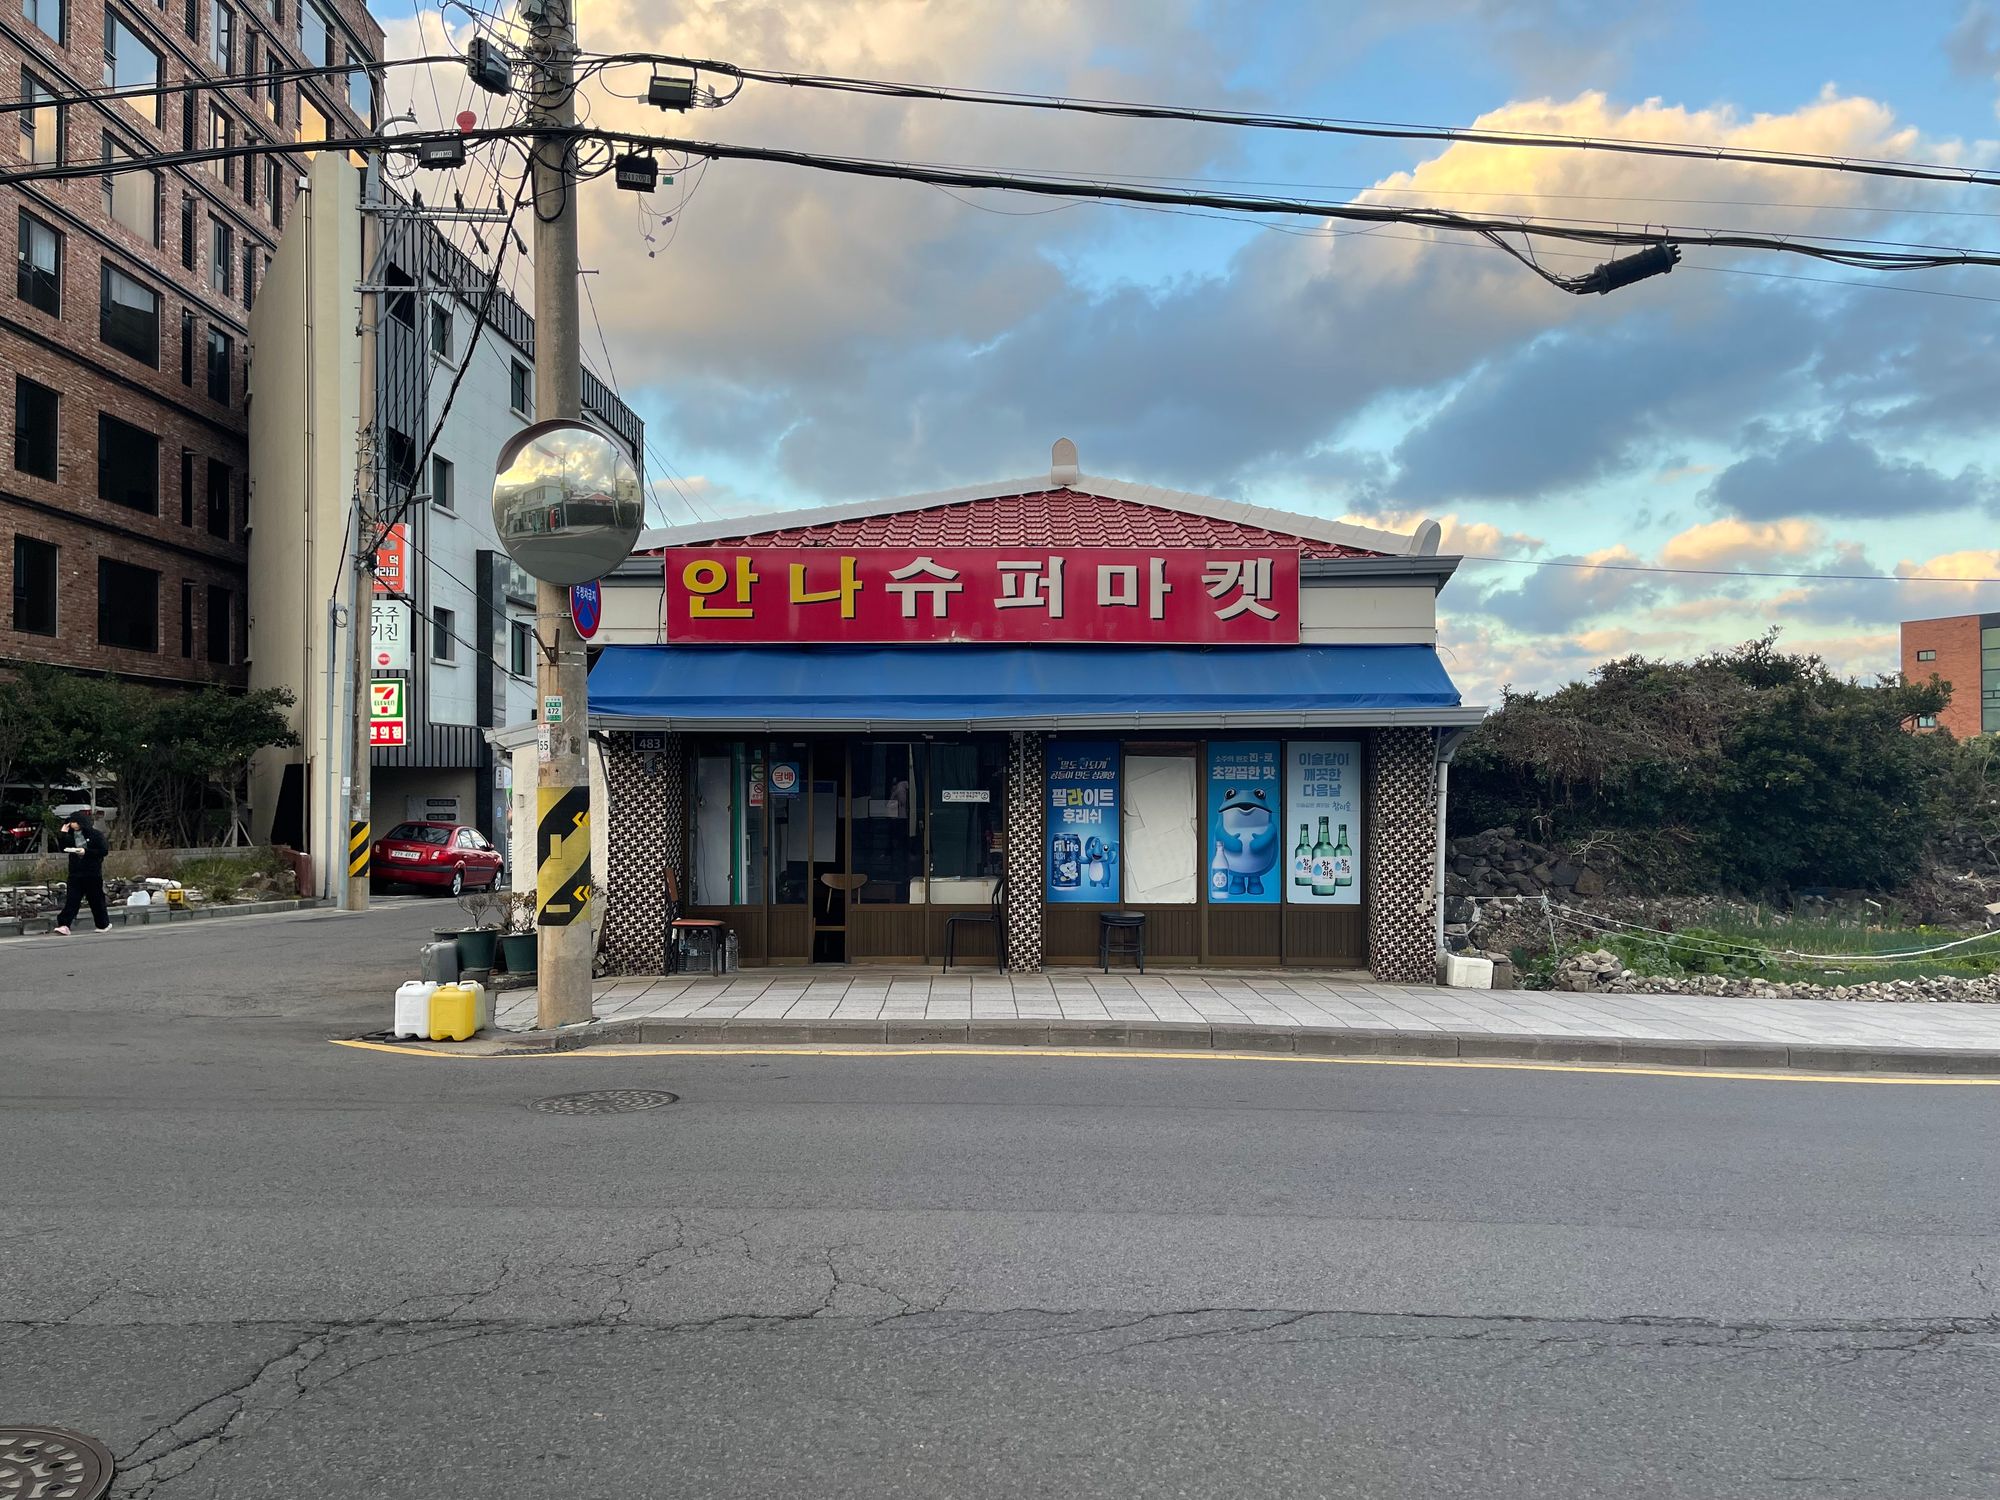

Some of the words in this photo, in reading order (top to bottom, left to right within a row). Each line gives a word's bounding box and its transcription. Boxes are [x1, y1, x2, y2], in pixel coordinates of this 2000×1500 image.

[639, 738, 661, 749] 483
[1299, 752, 1350, 766] 이슬같이
[775, 771, 794, 782] 담배
[1212, 765, 1261, 780] 초깔끔한
[1263, 766, 1276, 780] 맛
[1303, 768, 1342, 782] 깨끗한
[1303, 783, 1342, 797] 다음날
[1052, 788, 1114, 807] 필라이트
[1063, 808, 1102, 824] 후레쉬
